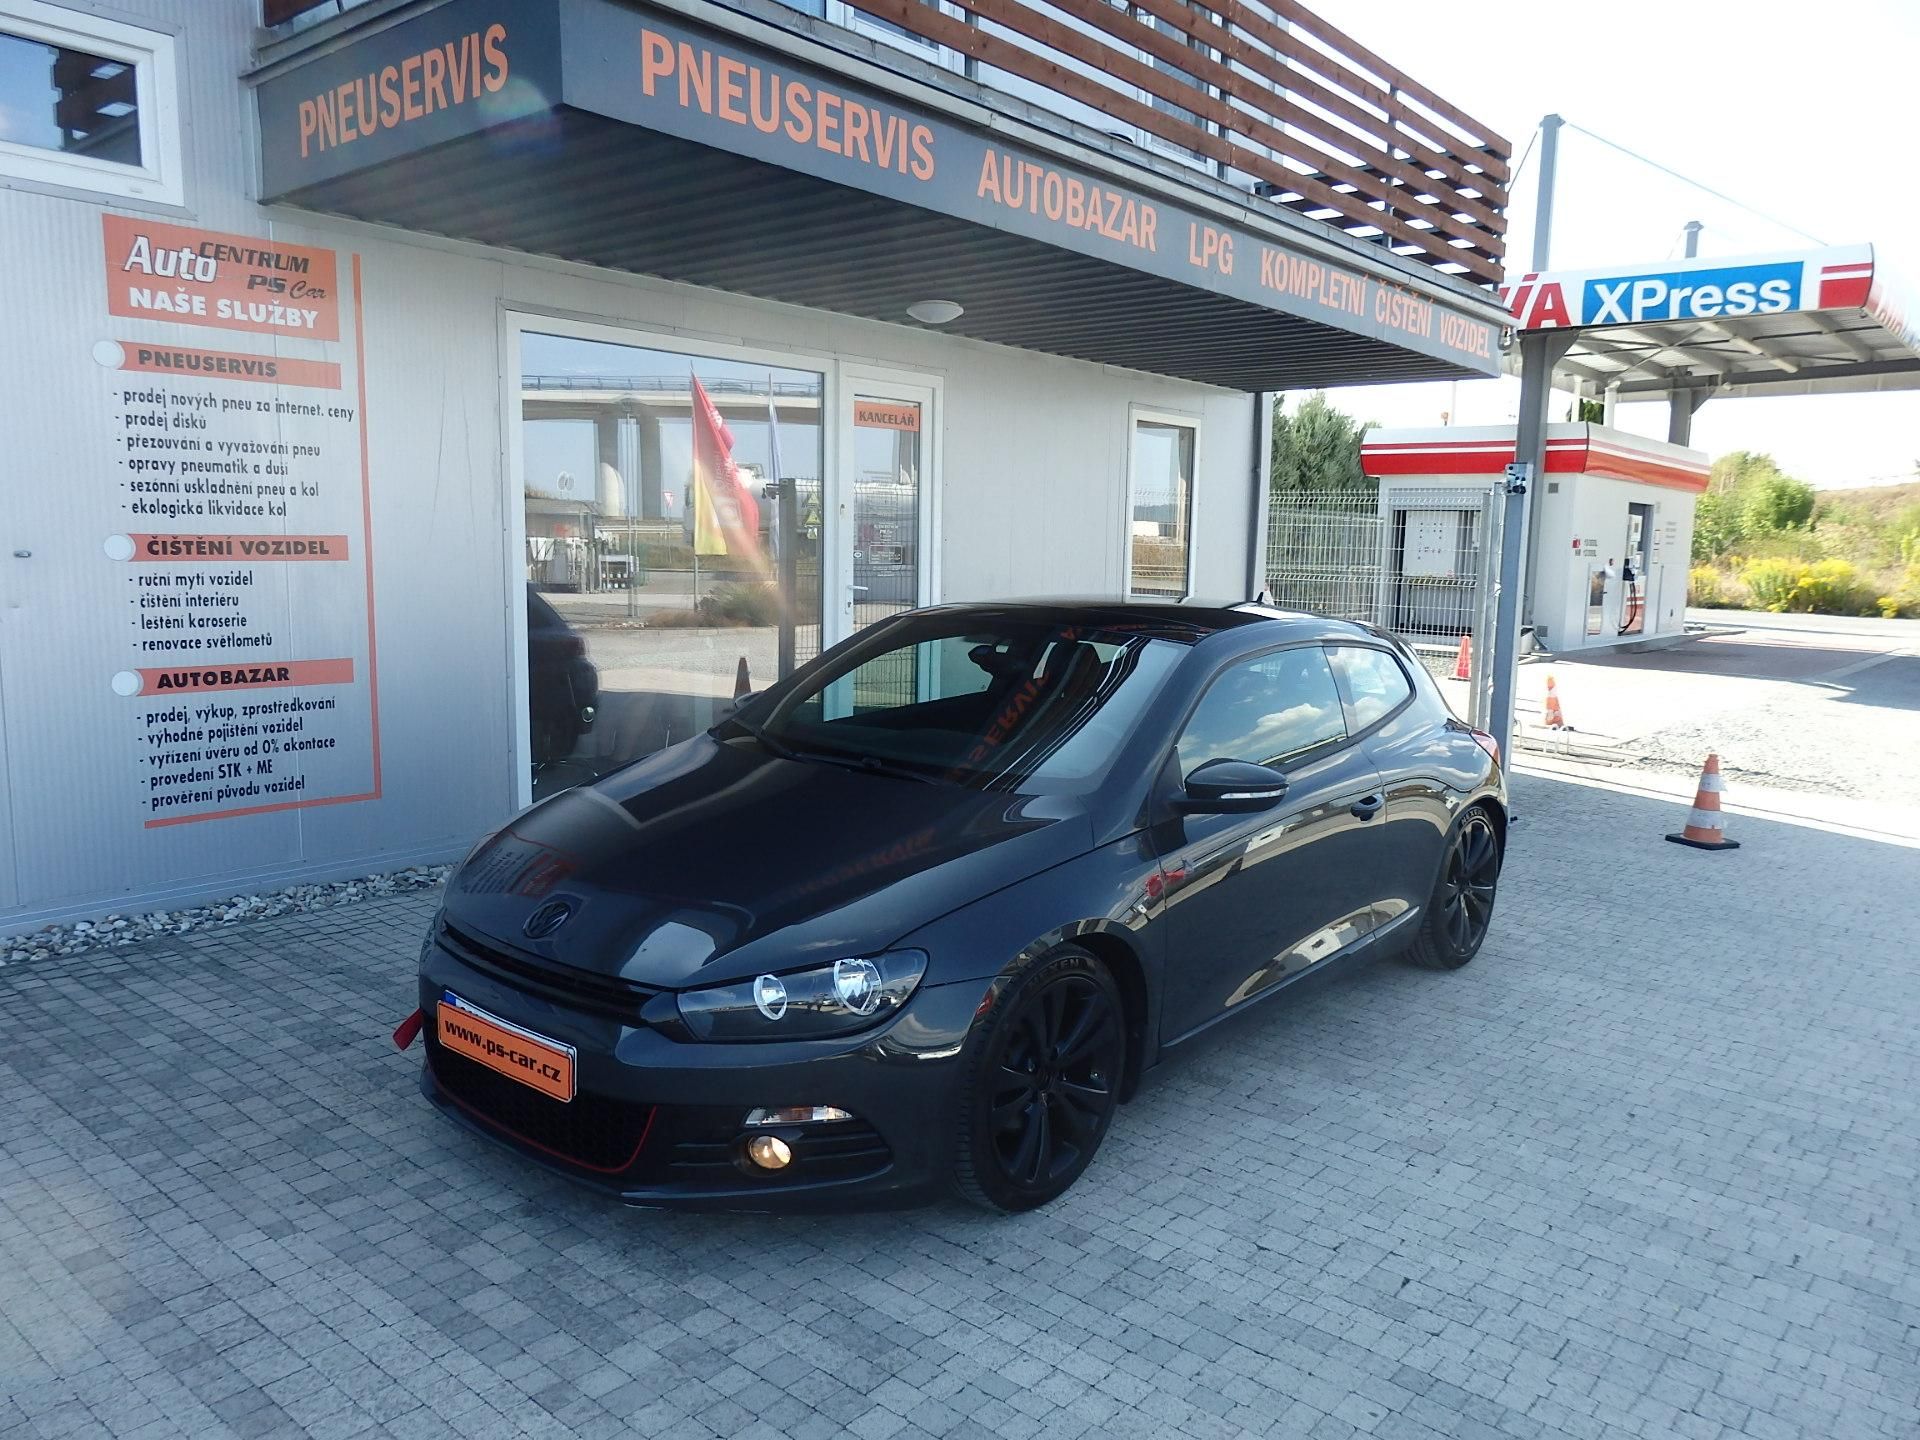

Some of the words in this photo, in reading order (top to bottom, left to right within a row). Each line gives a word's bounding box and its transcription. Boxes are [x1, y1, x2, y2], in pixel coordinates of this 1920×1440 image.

[300, 23, 508, 159] PNEUSERVIS
[641, 28, 935, 181] PNEUSERVIS
[977, 149, 1157, 252] AUTOBAZAR
[1189, 223, 1234, 275] LPG
[1261, 248, 1369, 317] KOMPLETNÍ
[1375, 279, 1434, 338] ČIŠTĚNÍ
[1440, 311, 1490, 358] VOZIDEL
[122, 234, 218, 283] Auto
[200, 241, 310, 274] CENTRUM
[247, 275, 287, 293] PS
[290, 280, 327, 299] Car
[128, 287, 207, 316] NAŠE
[217, 299, 319, 329] SLUŽBY
[1499, 273, 1572, 329] IA
[1590, 278, 1793, 325] XPress
[138, 349, 278, 378] PNEUSERVIS
[124, 387, 167, 409] prodej
[171, 392, 217, 411] nových
[222, 398, 252, 412] pneu
[257, 401, 270, 412] za
[275, 398, 324, 417] internet.
[328, 407, 354, 422] ceny
[125, 410, 168, 431] prodej
[173, 411, 207, 430] disků
[859, 411, 915, 427] KANCELÁŘ
[127, 434, 201, 451] přezouvání
[206, 441, 213, 451] a
[218, 440, 289, 456] vyvažování
[293, 444, 321, 459] pneu
[129, 459, 175, 475] opravy
[182, 458, 249, 475] pneumatik
[254, 464, 261, 474] a
[130, 478, 180, 493] sezónní
[184, 478, 253, 495] uskladnění
[257, 485, 285, 499] pneu
[290, 486, 297, 496] a
[301, 481, 319, 497] kol
[132, 498, 203, 518] ekologická
[208, 500, 264, 516] likvidace
[269, 501, 287, 516] kol
[147, 536, 233, 556] ČIŠTĚNÍ
[240, 541, 330, 555] VOZIDEL
[139, 571, 171, 587] ruční
[209, 570, 253, 586] vozidel
[140, 592, 182, 608] čištění
[186, 591, 239, 607] interiéru
[141, 613, 185, 630] leštění
[188, 611, 247, 628] karoserie
[143, 639, 202, 651] renovace
[206, 632, 273, 649] světlometů
[157, 667, 290, 689] AUTOBAZAR
[196, 703, 237, 723] výkup,
[242, 696, 335, 719] zprostředkování
[148, 726, 203, 748] výhodné
[208, 722, 258, 743] pojištění
[262, 717, 303, 734] vozidel
[149, 747, 201, 769] vyřízení
[205, 745, 239, 760] úvěru
[244, 741, 258, 756] od
[262, 738, 279, 754] 0%
[283, 737, 335, 752] akontace
[151, 766, 214, 791] provedení
[218, 762, 242, 779] STK
[256, 759, 273, 774] ME
[152, 786, 213, 811] prověření
[217, 781, 260, 803] původu
[264, 775, 305, 793] vozidel
[445, 1020, 562, 1083] www.ps-car.cz
